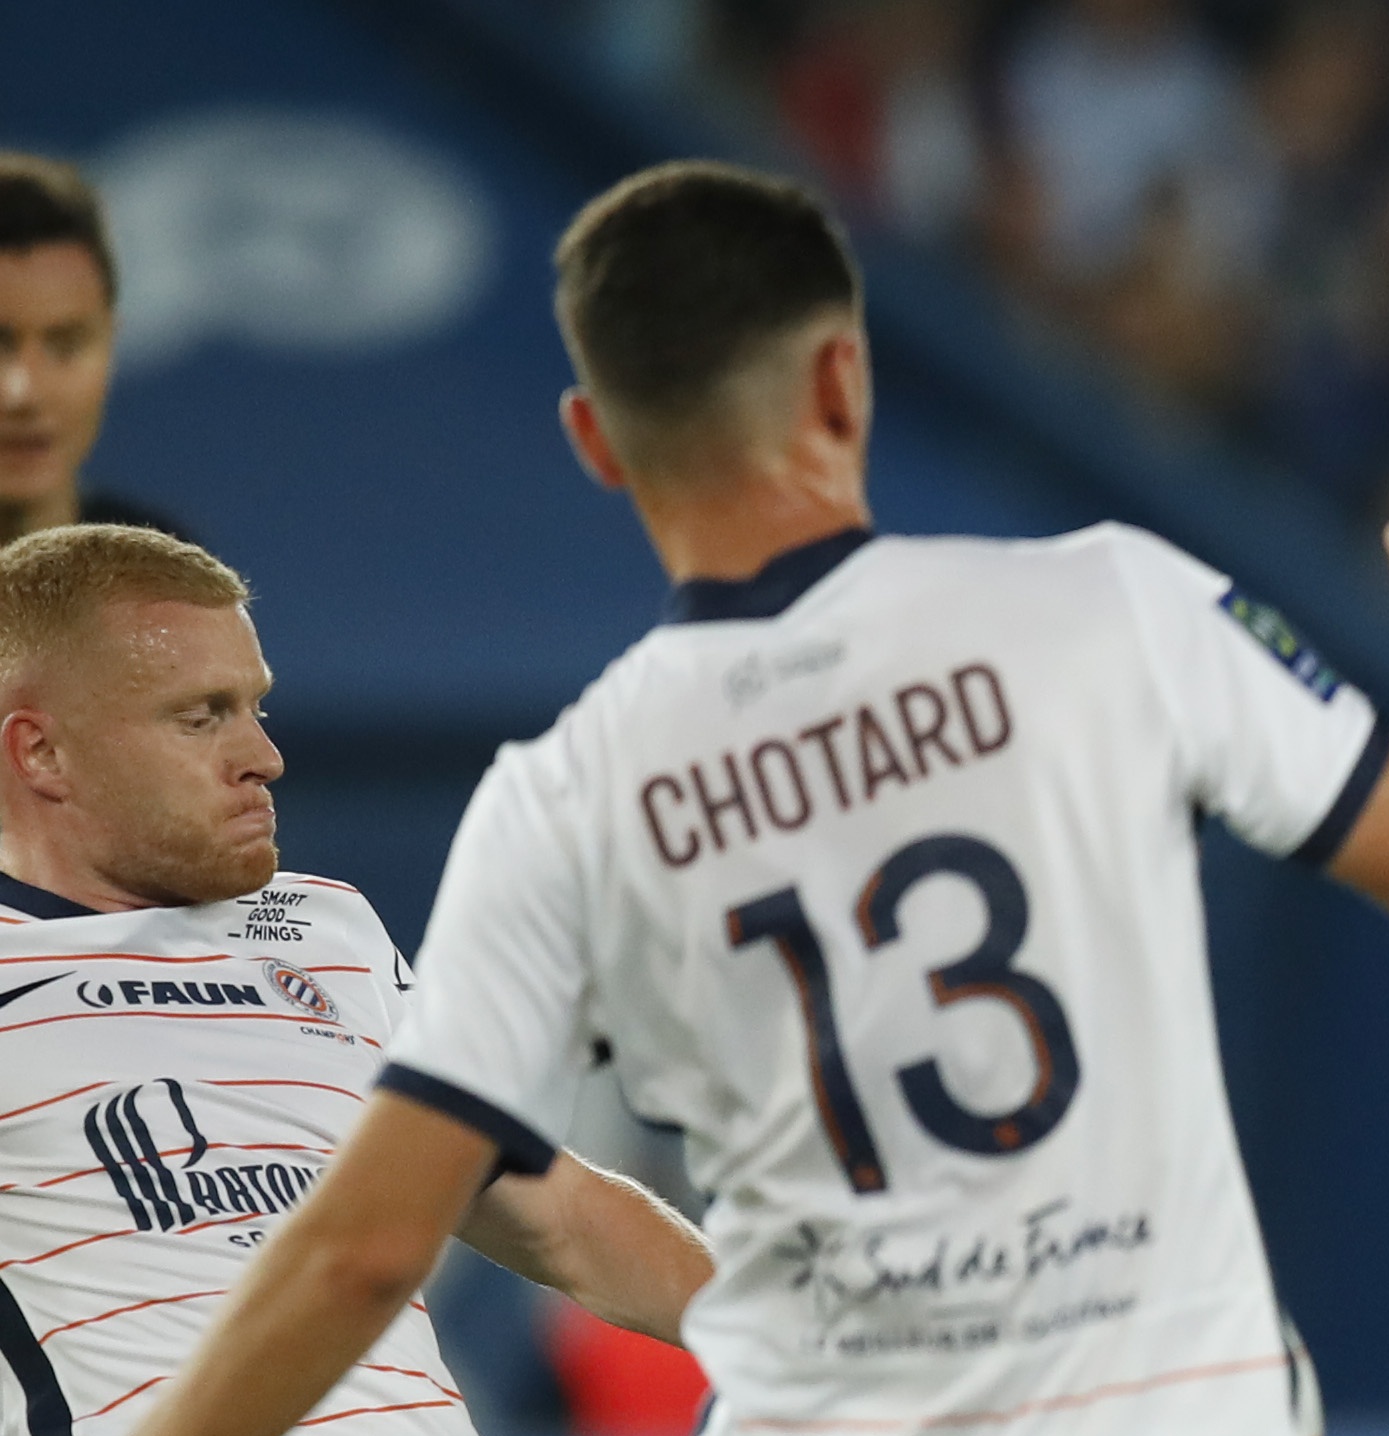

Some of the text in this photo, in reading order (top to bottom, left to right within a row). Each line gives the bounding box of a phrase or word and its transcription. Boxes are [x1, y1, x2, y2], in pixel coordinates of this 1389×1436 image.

[639, 661, 1014, 870] CHOTARD
[260, 890, 308, 907] SMART
[247, 908, 285, 922] GOOD
[244, 924, 303, 942] THINGS
[118, 980, 267, 1007] FAUN
[728, 833, 1081, 1194] 13
